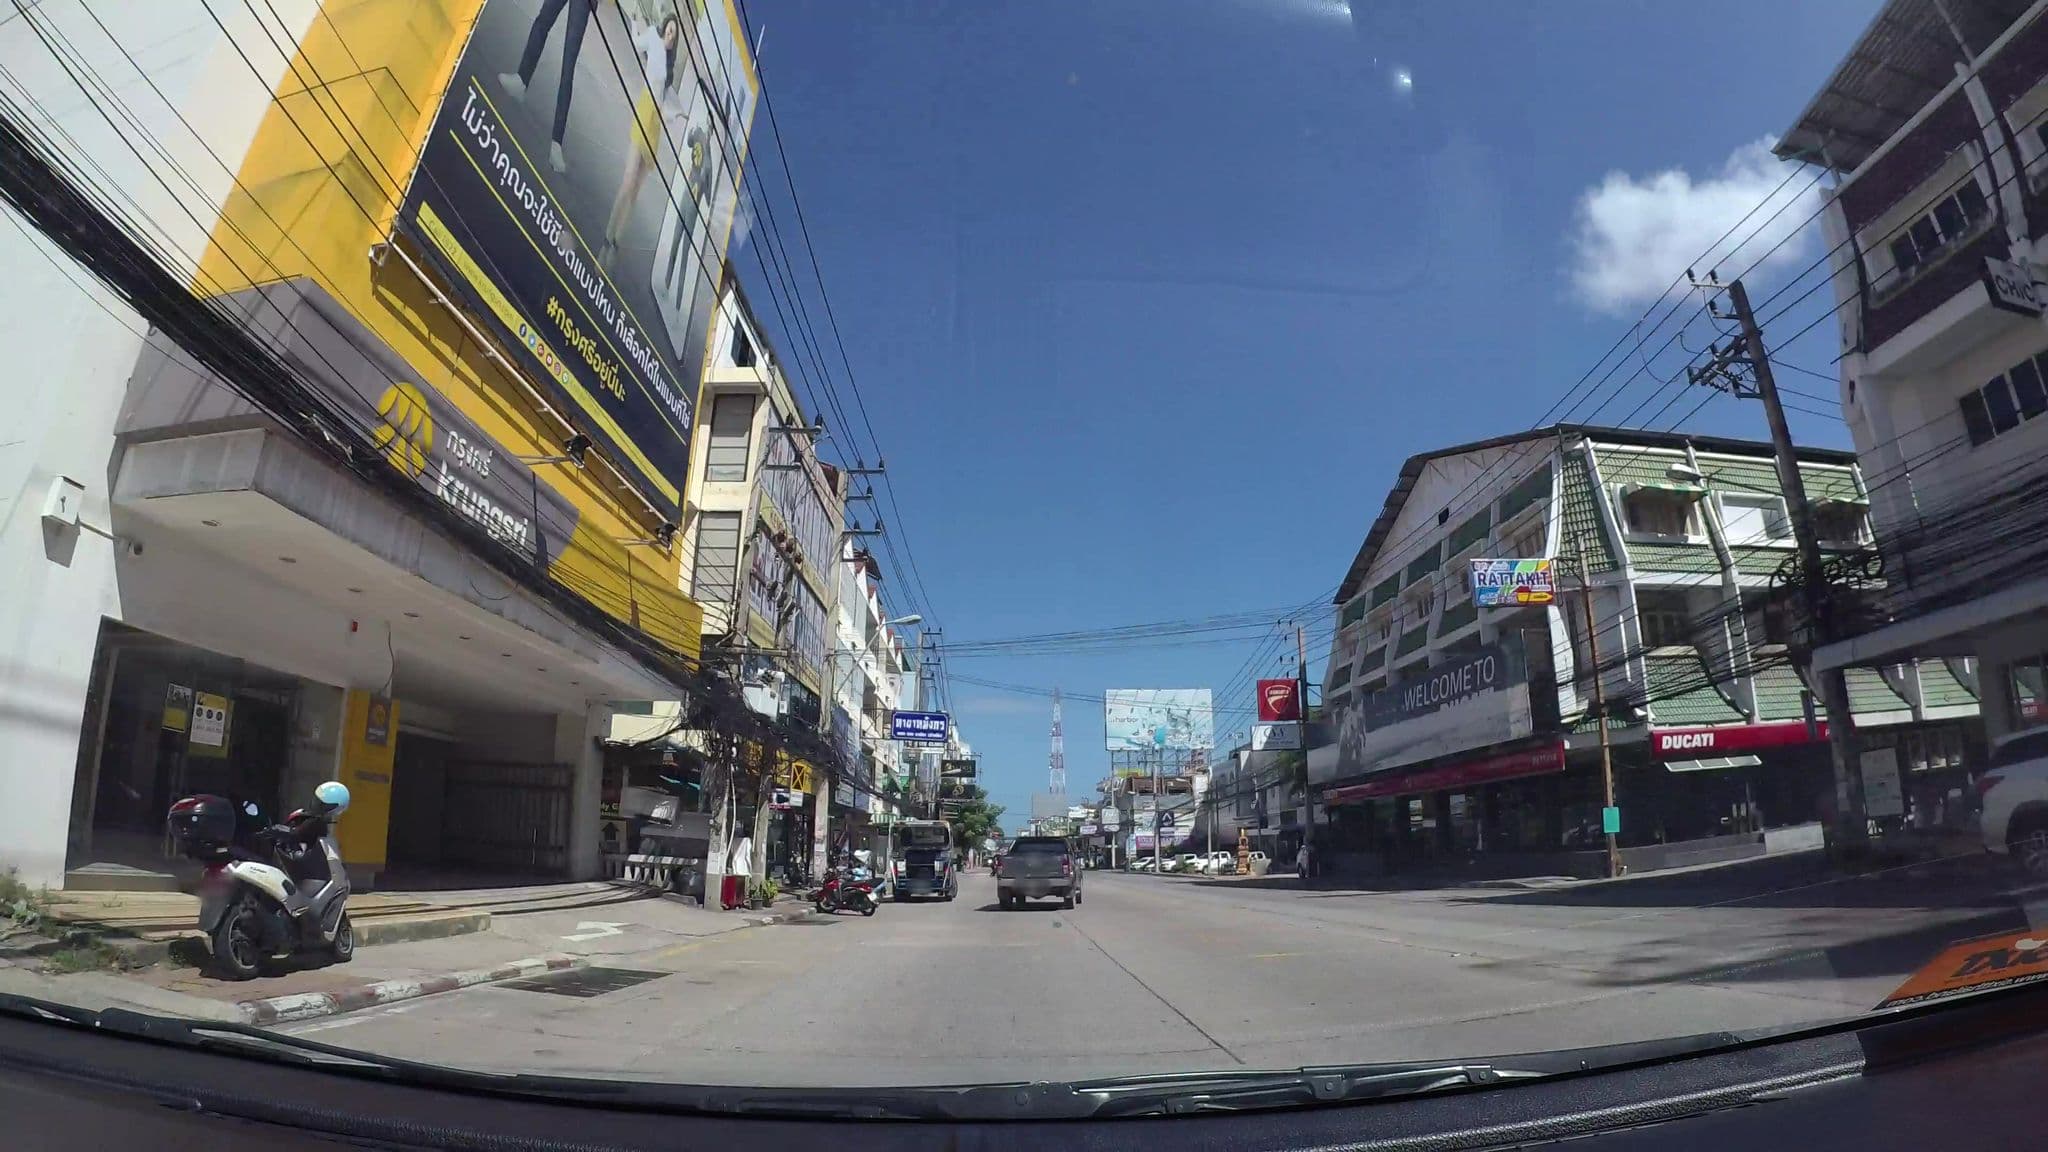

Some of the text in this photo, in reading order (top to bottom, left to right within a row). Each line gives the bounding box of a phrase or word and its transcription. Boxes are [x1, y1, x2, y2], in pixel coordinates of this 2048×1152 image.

[1995, 275, 2035, 303] CHIC
[436, 458, 528, 546] krungsri
[1477, 572, 1548, 586] RATTAKIT
[1404, 664, 1472, 711] WELCOME
[1474, 655, 1495, 686] TO
[1662, 733, 1714, 749] DUCATI
